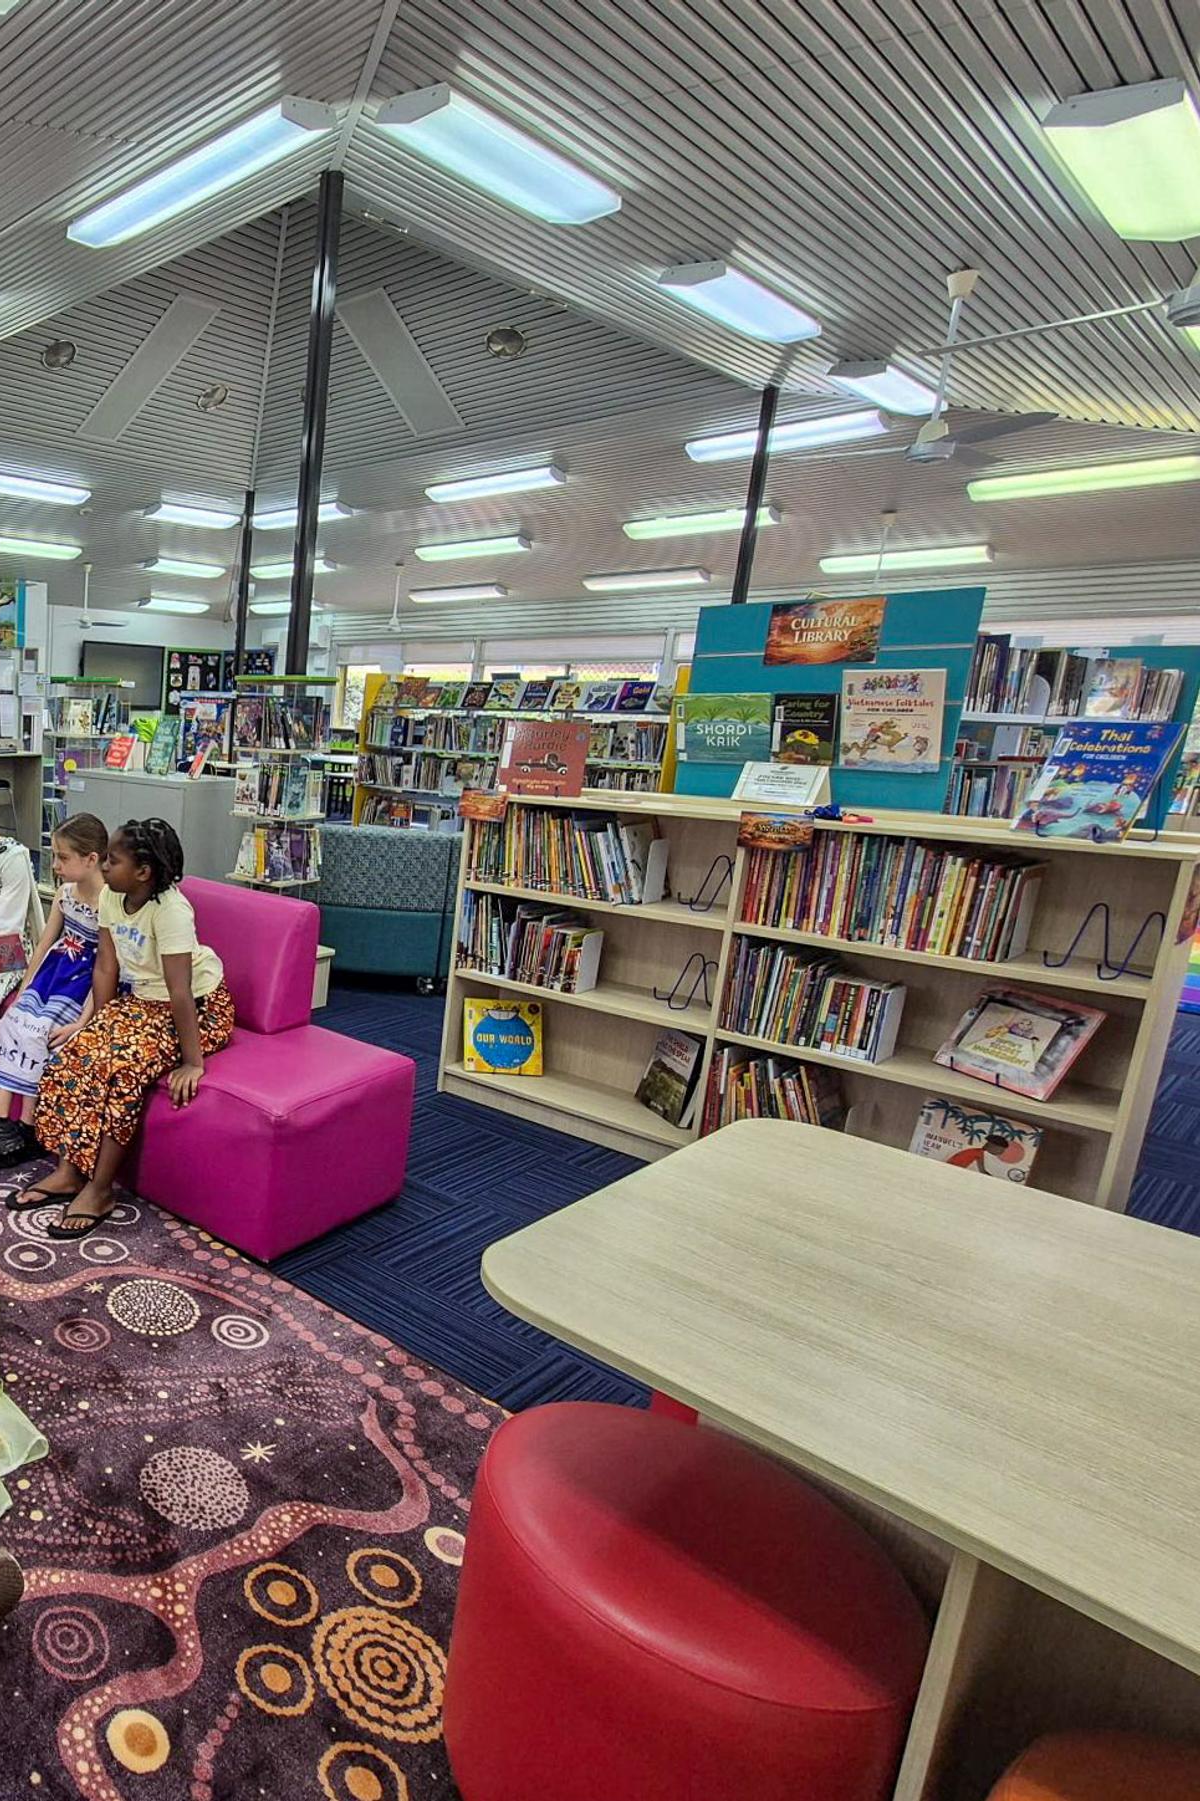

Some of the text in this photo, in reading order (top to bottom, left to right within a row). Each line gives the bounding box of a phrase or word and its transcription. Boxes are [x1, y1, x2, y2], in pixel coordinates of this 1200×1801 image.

[790, 615, 859, 631] CULTURAL
[793, 629, 853, 644] LIBRARY
[813, 698, 831, 709] for
[847, 698, 893, 708] Vietnamese
[783, 709, 825, 720] Country
[696, 723, 752, 736] SHORDI
[1100, 728, 1134, 742] Thai
[706, 735, 741, 747] KRIK
[1070, 740, 1151, 754] Celebrations
[1095, 753, 1126, 761] CHILDREN
[476, 1033, 533, 1046] OUR WORLD
